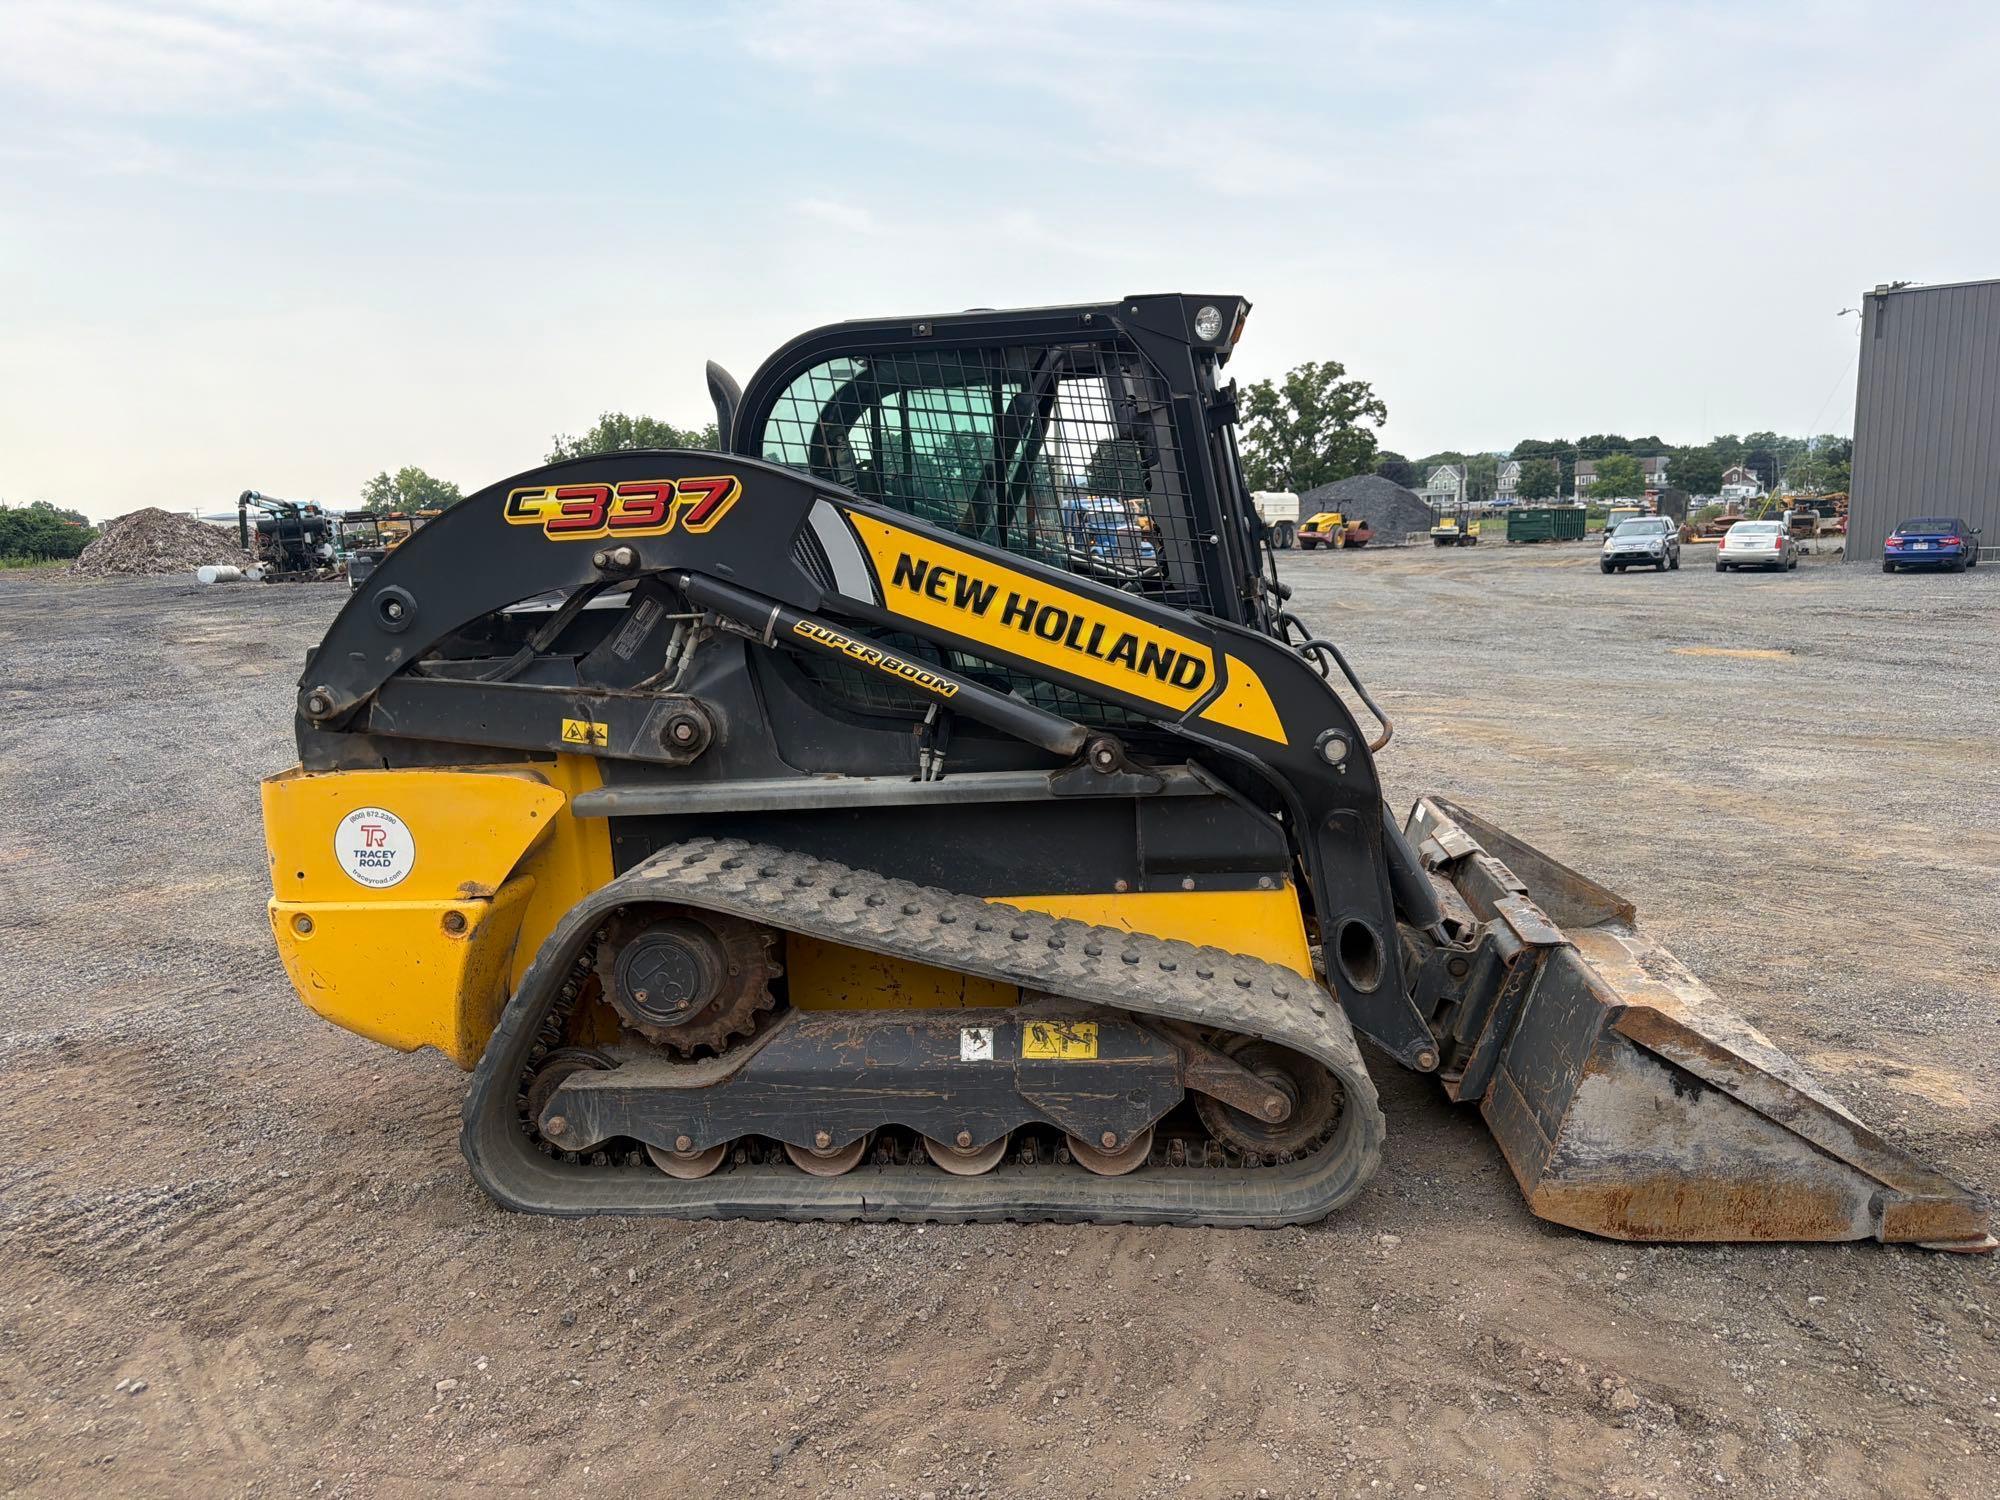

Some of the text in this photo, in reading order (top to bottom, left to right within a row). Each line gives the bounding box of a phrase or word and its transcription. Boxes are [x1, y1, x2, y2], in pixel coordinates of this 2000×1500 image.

[504, 474, 743, 541] C337
[891, 552, 1207, 690] NEW HOLLAND
[793, 620, 960, 698] SUPER BOOM
[353, 850, 396, 859] TRACEY
[359, 859, 391, 867] ROAD
[353, 869, 401, 884] traceyroad.com
